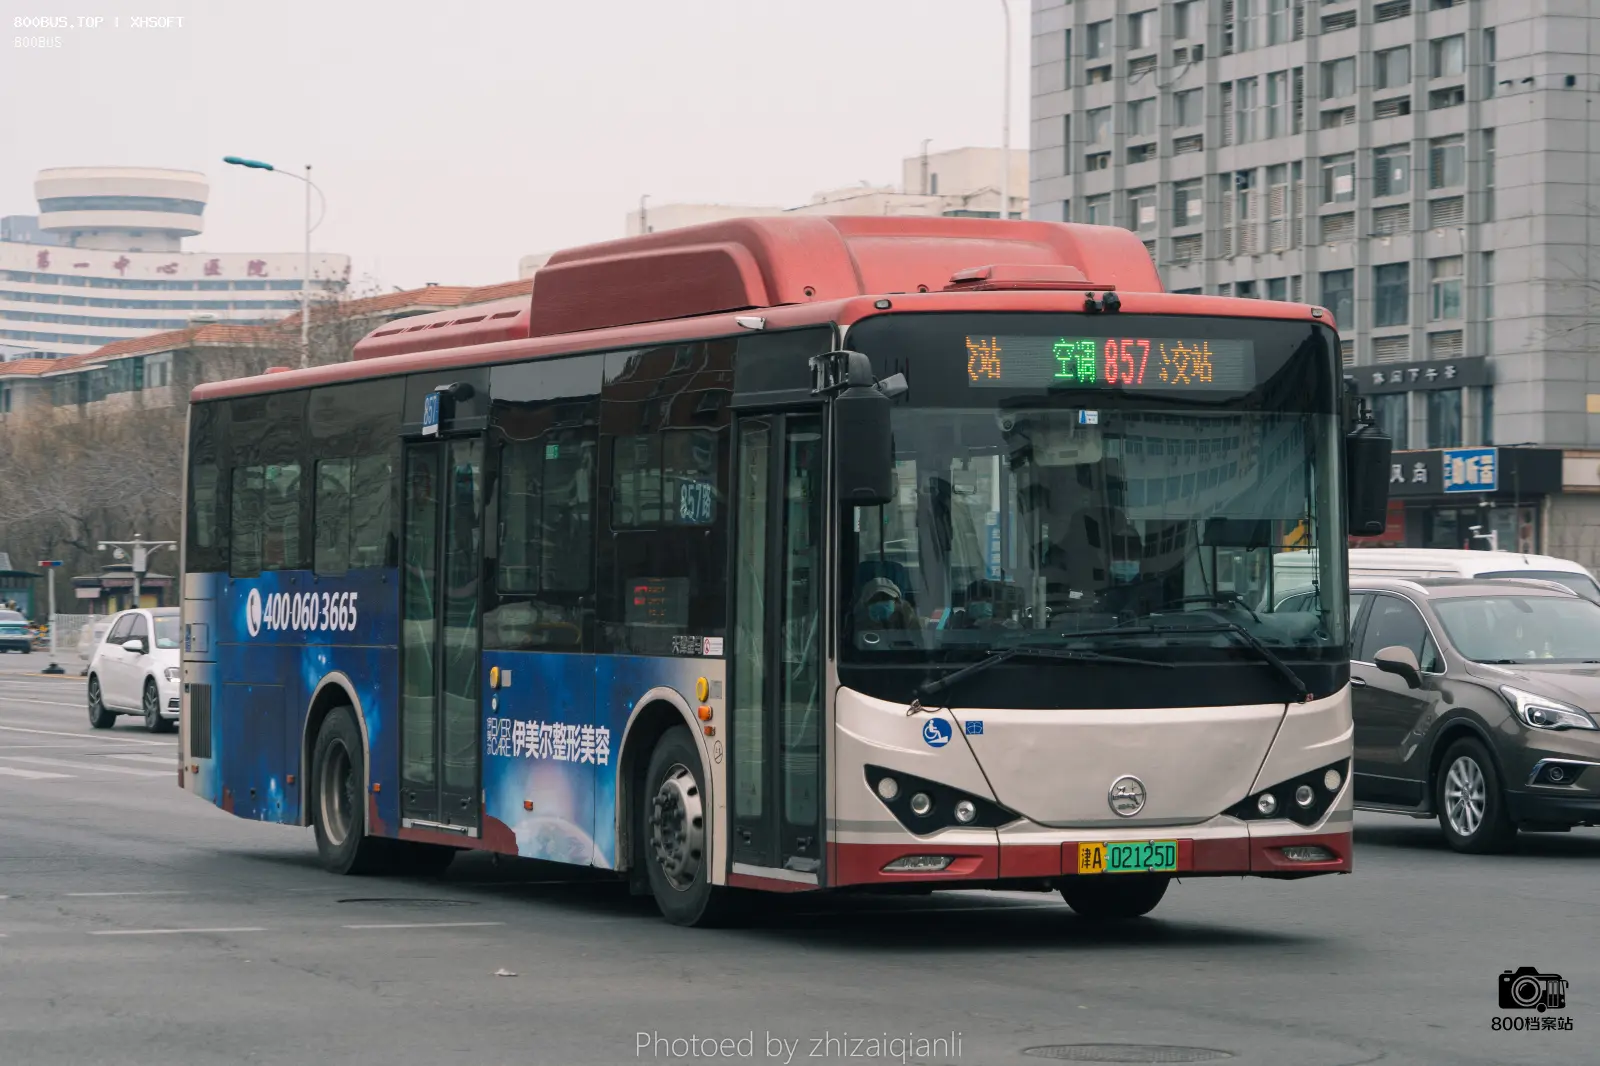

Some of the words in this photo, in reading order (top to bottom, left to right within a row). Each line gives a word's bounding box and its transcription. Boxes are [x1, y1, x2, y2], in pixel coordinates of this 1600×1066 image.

[1053, 338, 1095, 383] 空调
[1104, 339, 1150, 384] 857
[512, 719, 611, 766] 伊美尔整形美容
